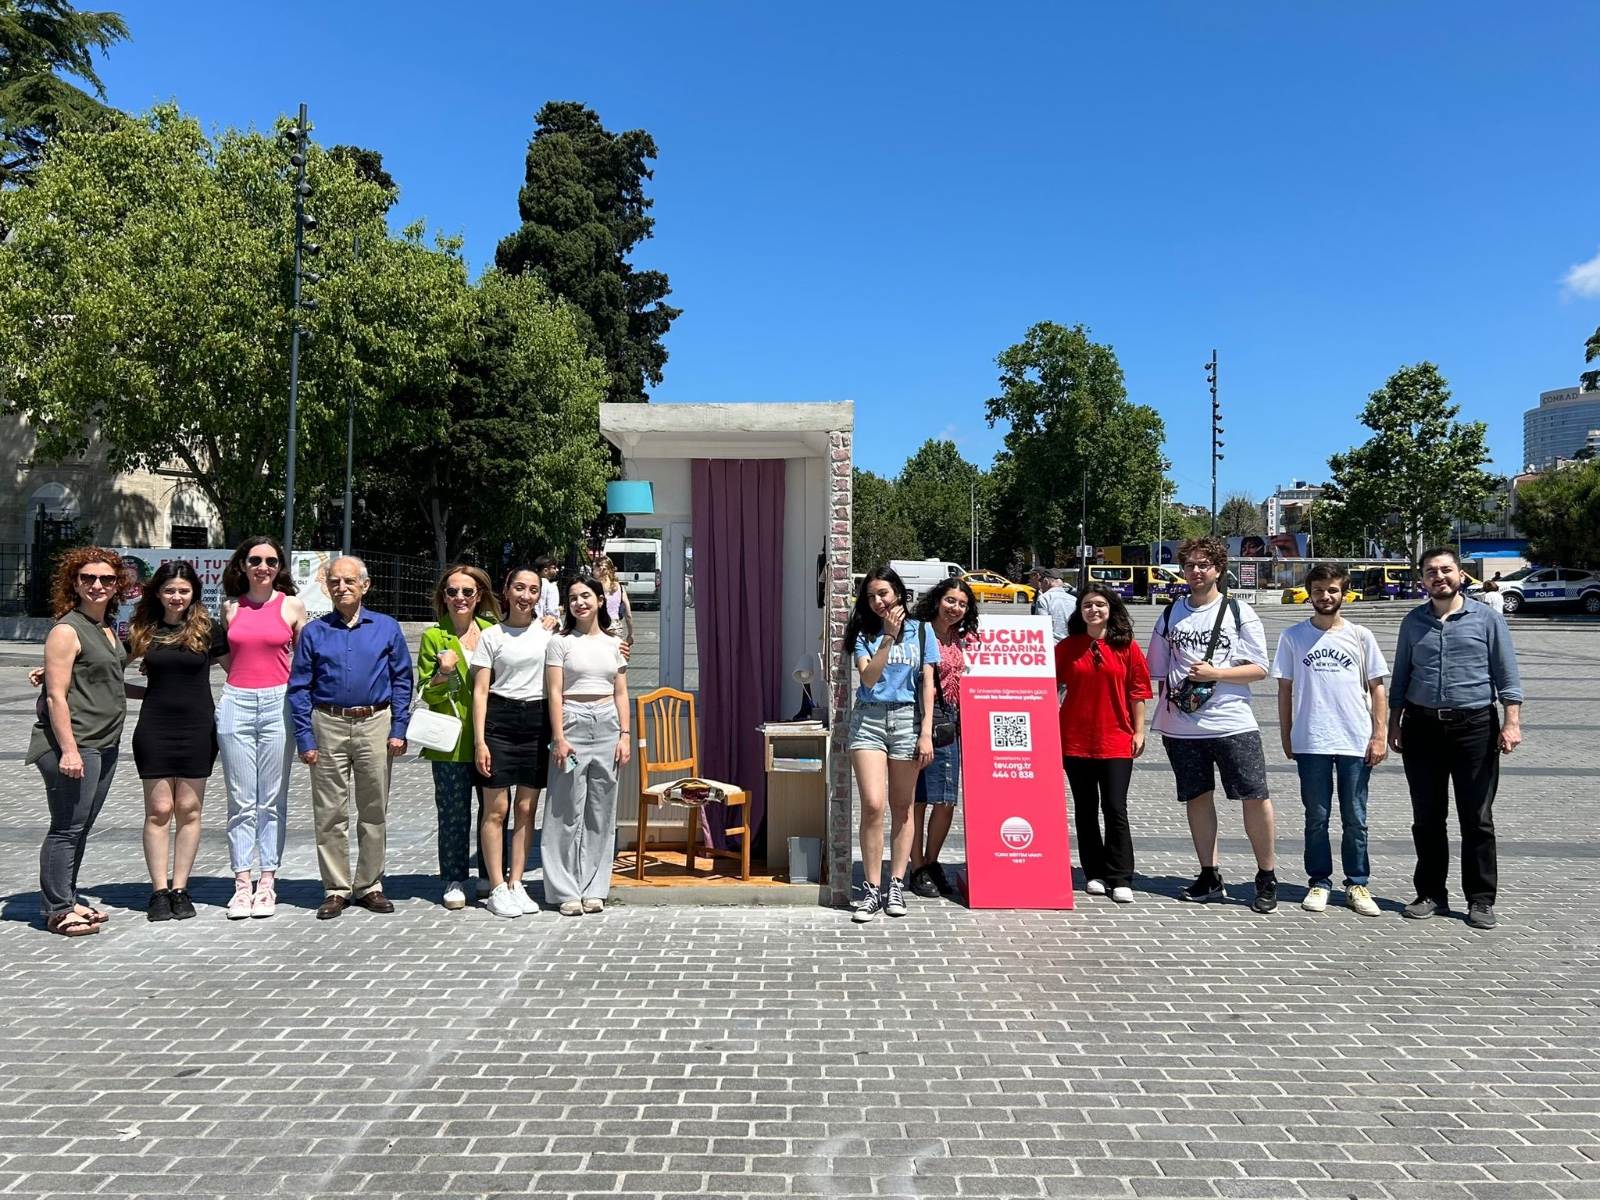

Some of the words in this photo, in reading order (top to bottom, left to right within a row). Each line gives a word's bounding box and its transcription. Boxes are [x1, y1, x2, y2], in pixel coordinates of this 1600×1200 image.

[1542, 393, 1578, 404] CONRAD
[984, 645, 1047, 653] KADARINA
[1302, 648, 1352, 668] BROOKLYN
[1005, 834, 1030, 842] TEV
